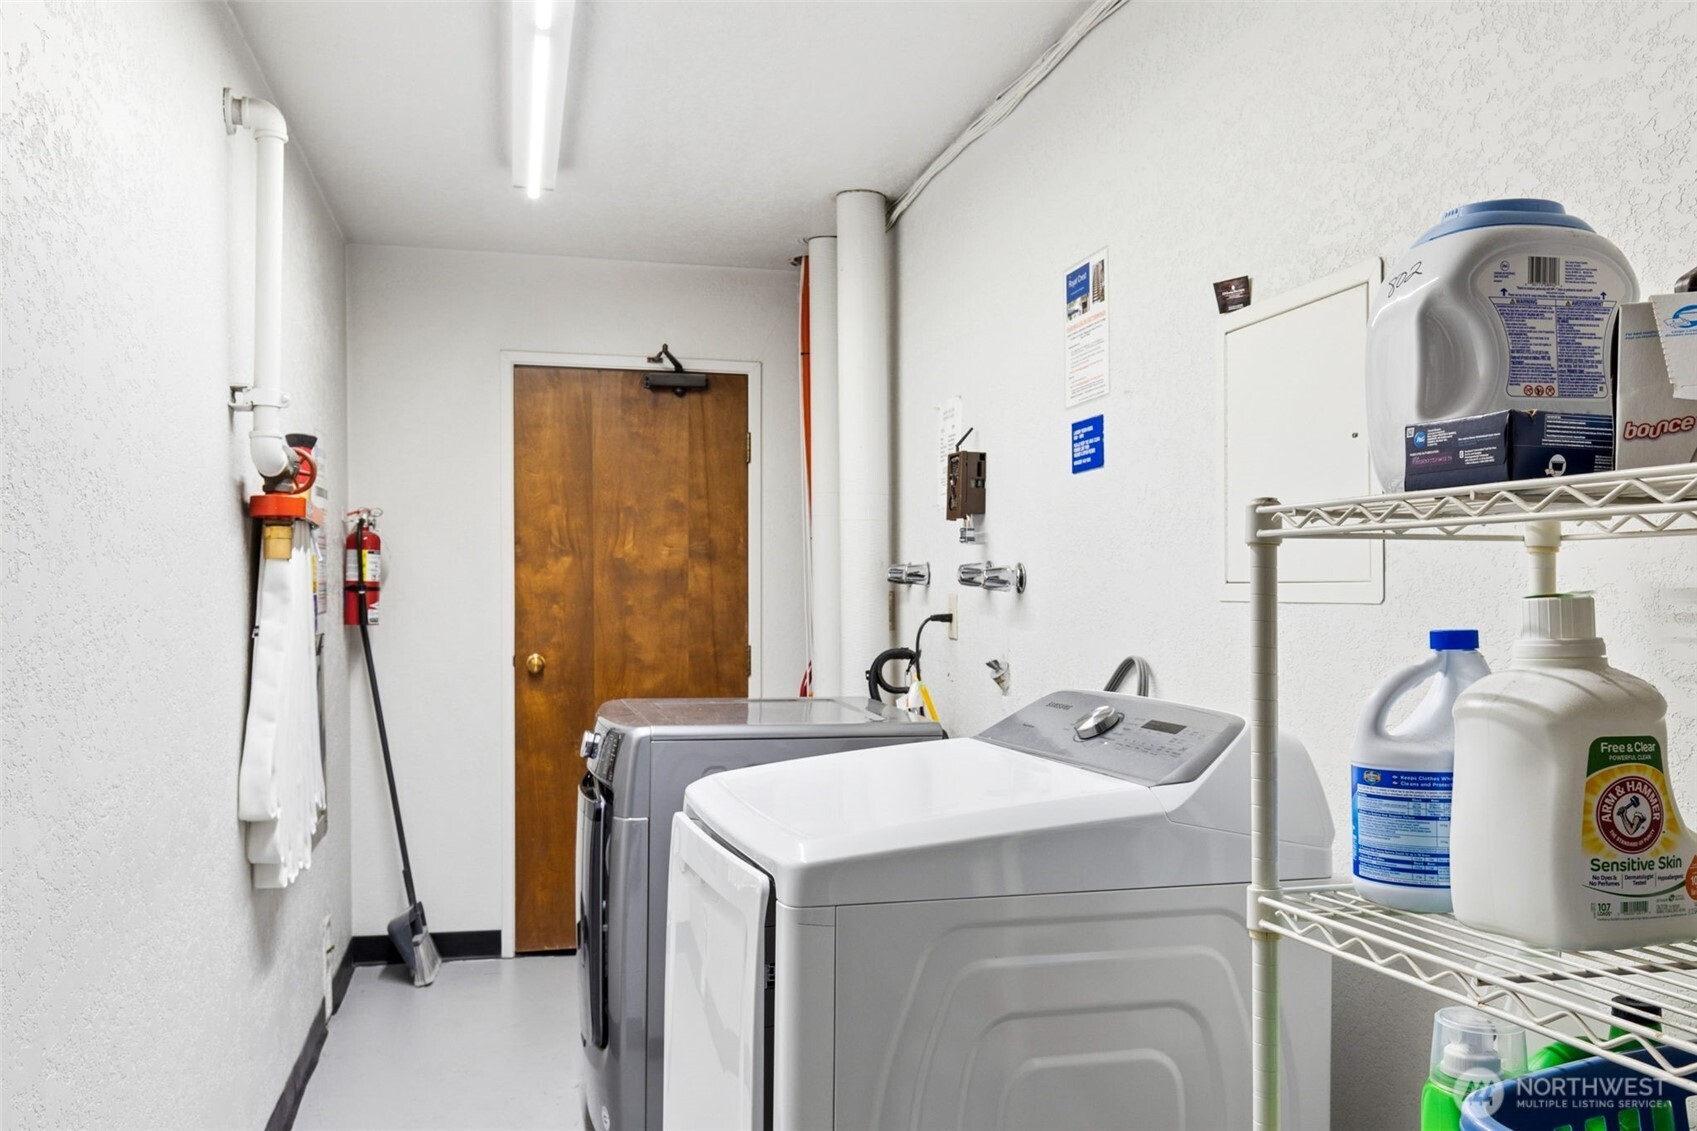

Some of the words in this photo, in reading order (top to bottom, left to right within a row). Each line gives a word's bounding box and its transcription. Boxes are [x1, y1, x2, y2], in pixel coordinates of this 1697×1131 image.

[1623, 415, 1696, 440] bounce
[1600, 742, 1625, 753] Free
[1626, 743, 1634, 753] &
[1634, 741, 1656, 752] Clear
[1601, 792, 1617, 823] ARM
[1614, 785, 1626, 796] &
[1626, 781, 1661, 821] HAMMER
[1590, 857, 1655, 873] Sensitive
[1658, 855, 1683, 870] Skin
[1597, 903, 1611, 912] 107
